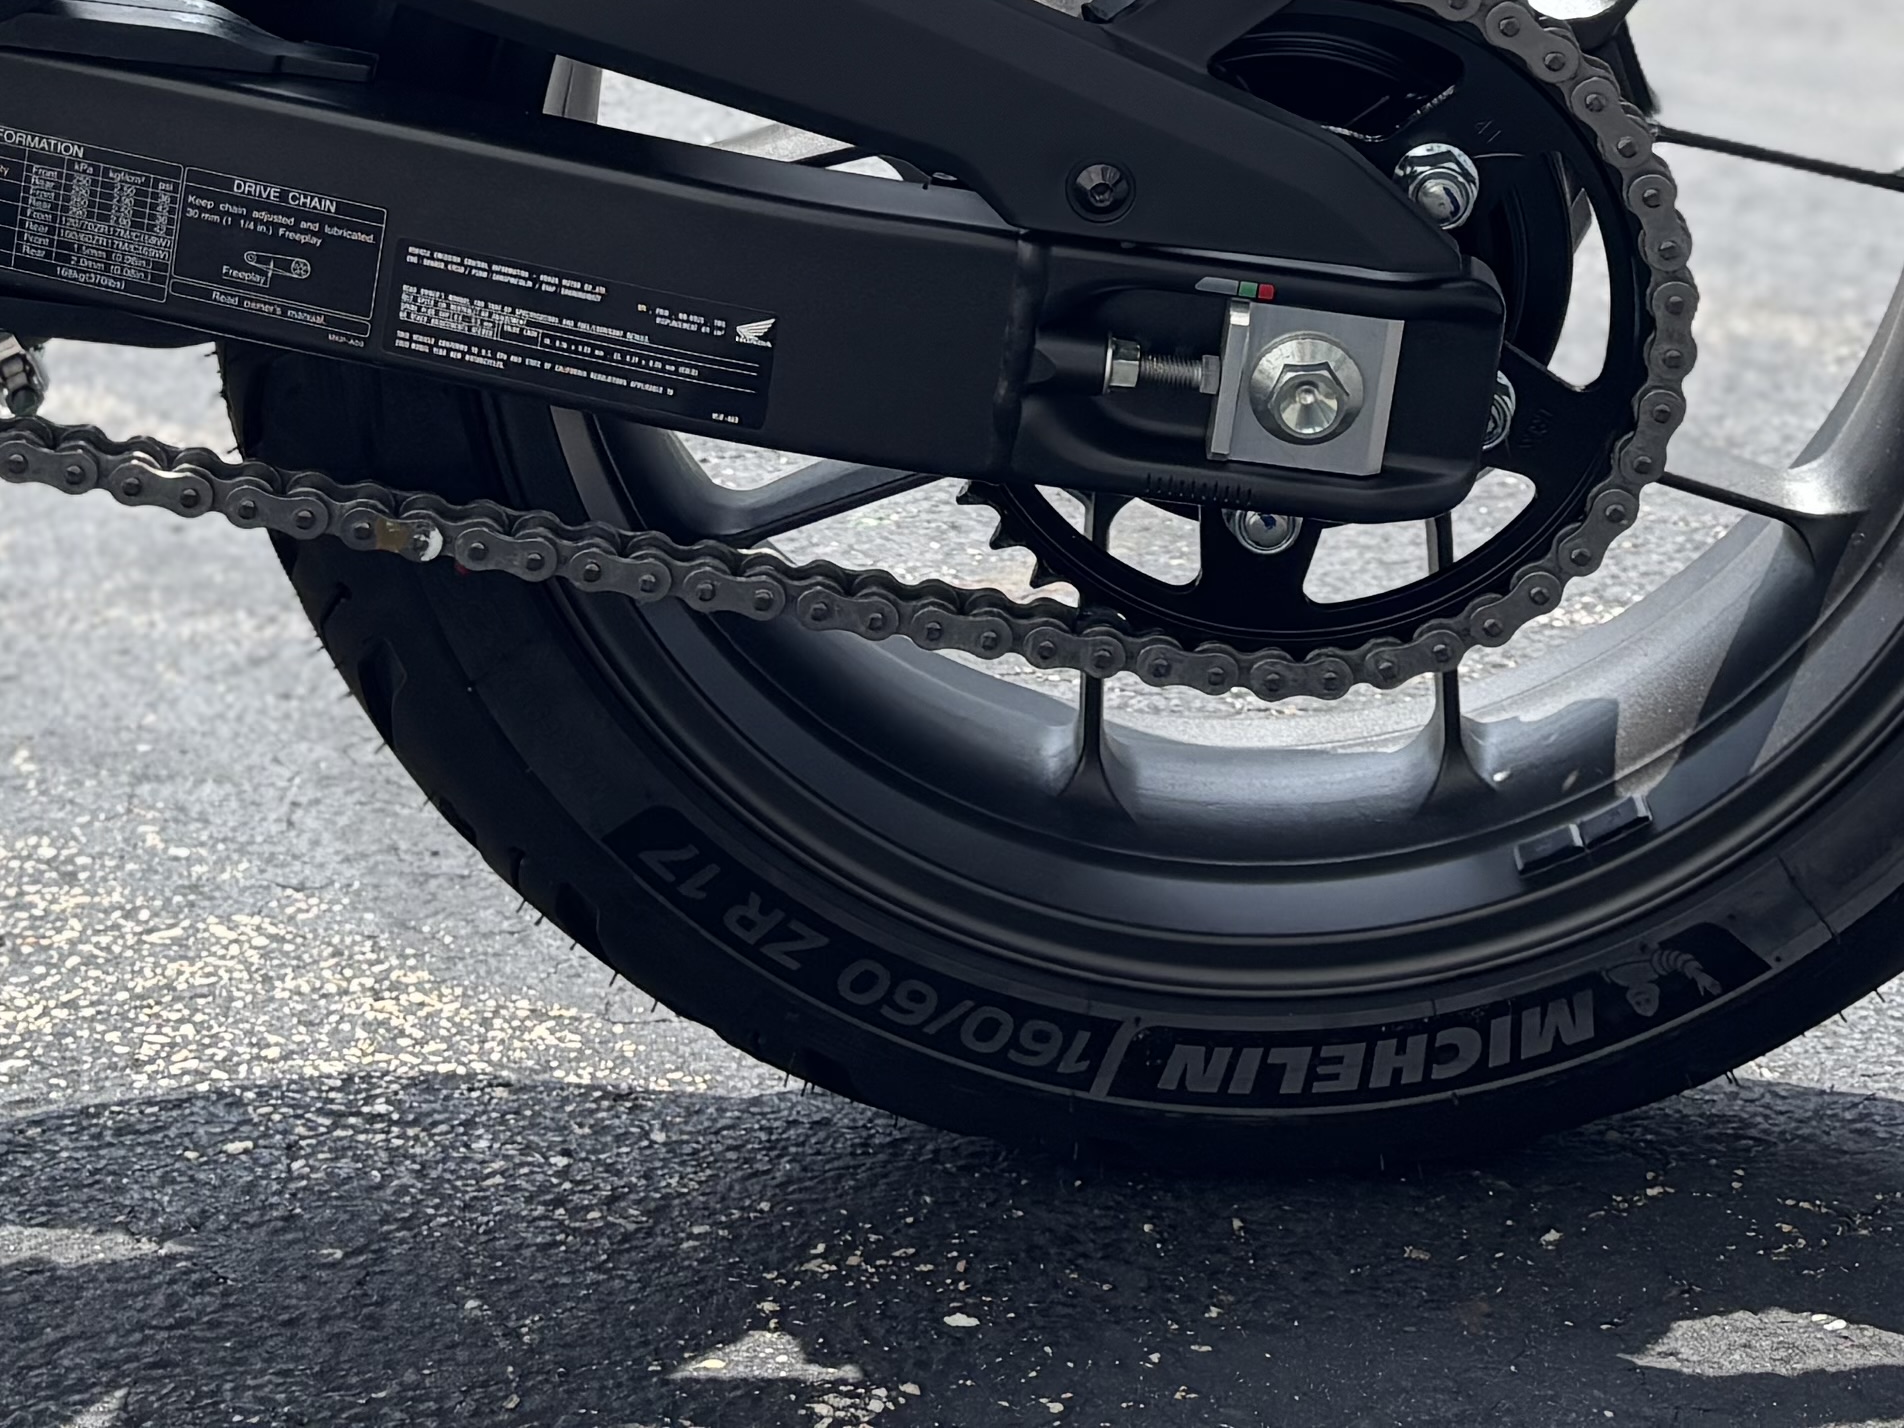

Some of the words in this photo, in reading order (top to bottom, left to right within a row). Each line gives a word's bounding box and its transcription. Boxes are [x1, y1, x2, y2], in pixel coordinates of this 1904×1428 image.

[187, 194, 215, 209] Keep
[219, 201, 247, 215] chain
[251, 208, 294, 227] adjusted
[299, 219, 319, 231] and
[324, 223, 376, 244] lubricated.
[233, 179, 281, 201] DRIVE
[287, 191, 337, 213] CHAIN
[185, 207, 198, 218] 30
[277, 227, 323, 247] Freeplay
[211, 291, 239, 305] Read
[221, 265, 266, 284] Freeplay
[637, 843, 722, 900] 17
[723, 892, 830, 971] ZR
[836, 958, 1094, 1075] 160/60
[1157, 989, 1596, 1095] MICHELIN
